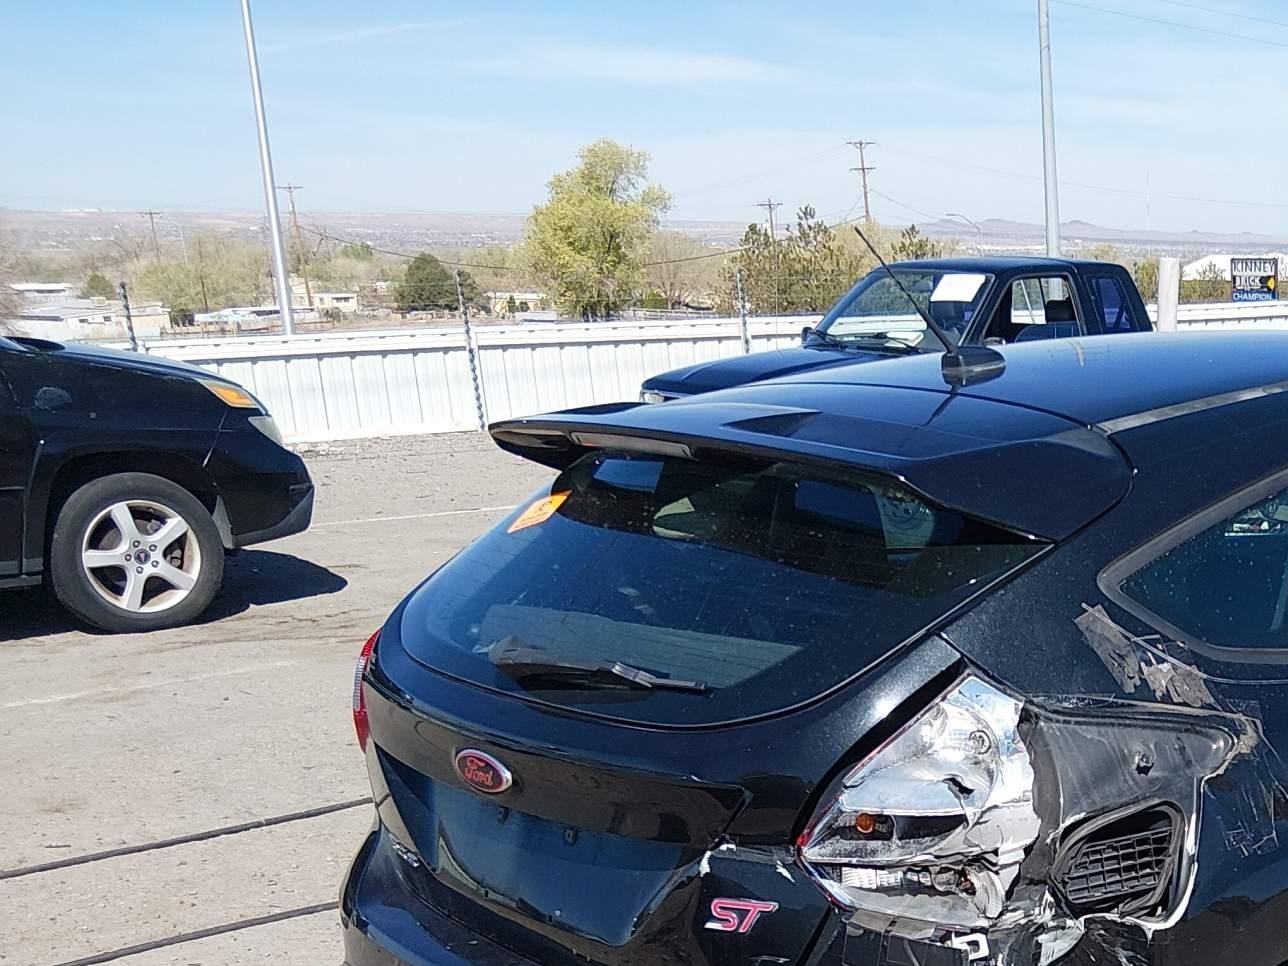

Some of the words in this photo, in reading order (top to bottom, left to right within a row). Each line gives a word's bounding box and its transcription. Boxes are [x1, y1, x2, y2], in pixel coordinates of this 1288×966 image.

[1233, 260, 1275, 272] KINNEY
[1233, 292, 1272, 300] CHAMPION
[464, 757, 494, 786] Ford
[704, 897, 779, 934] ST
